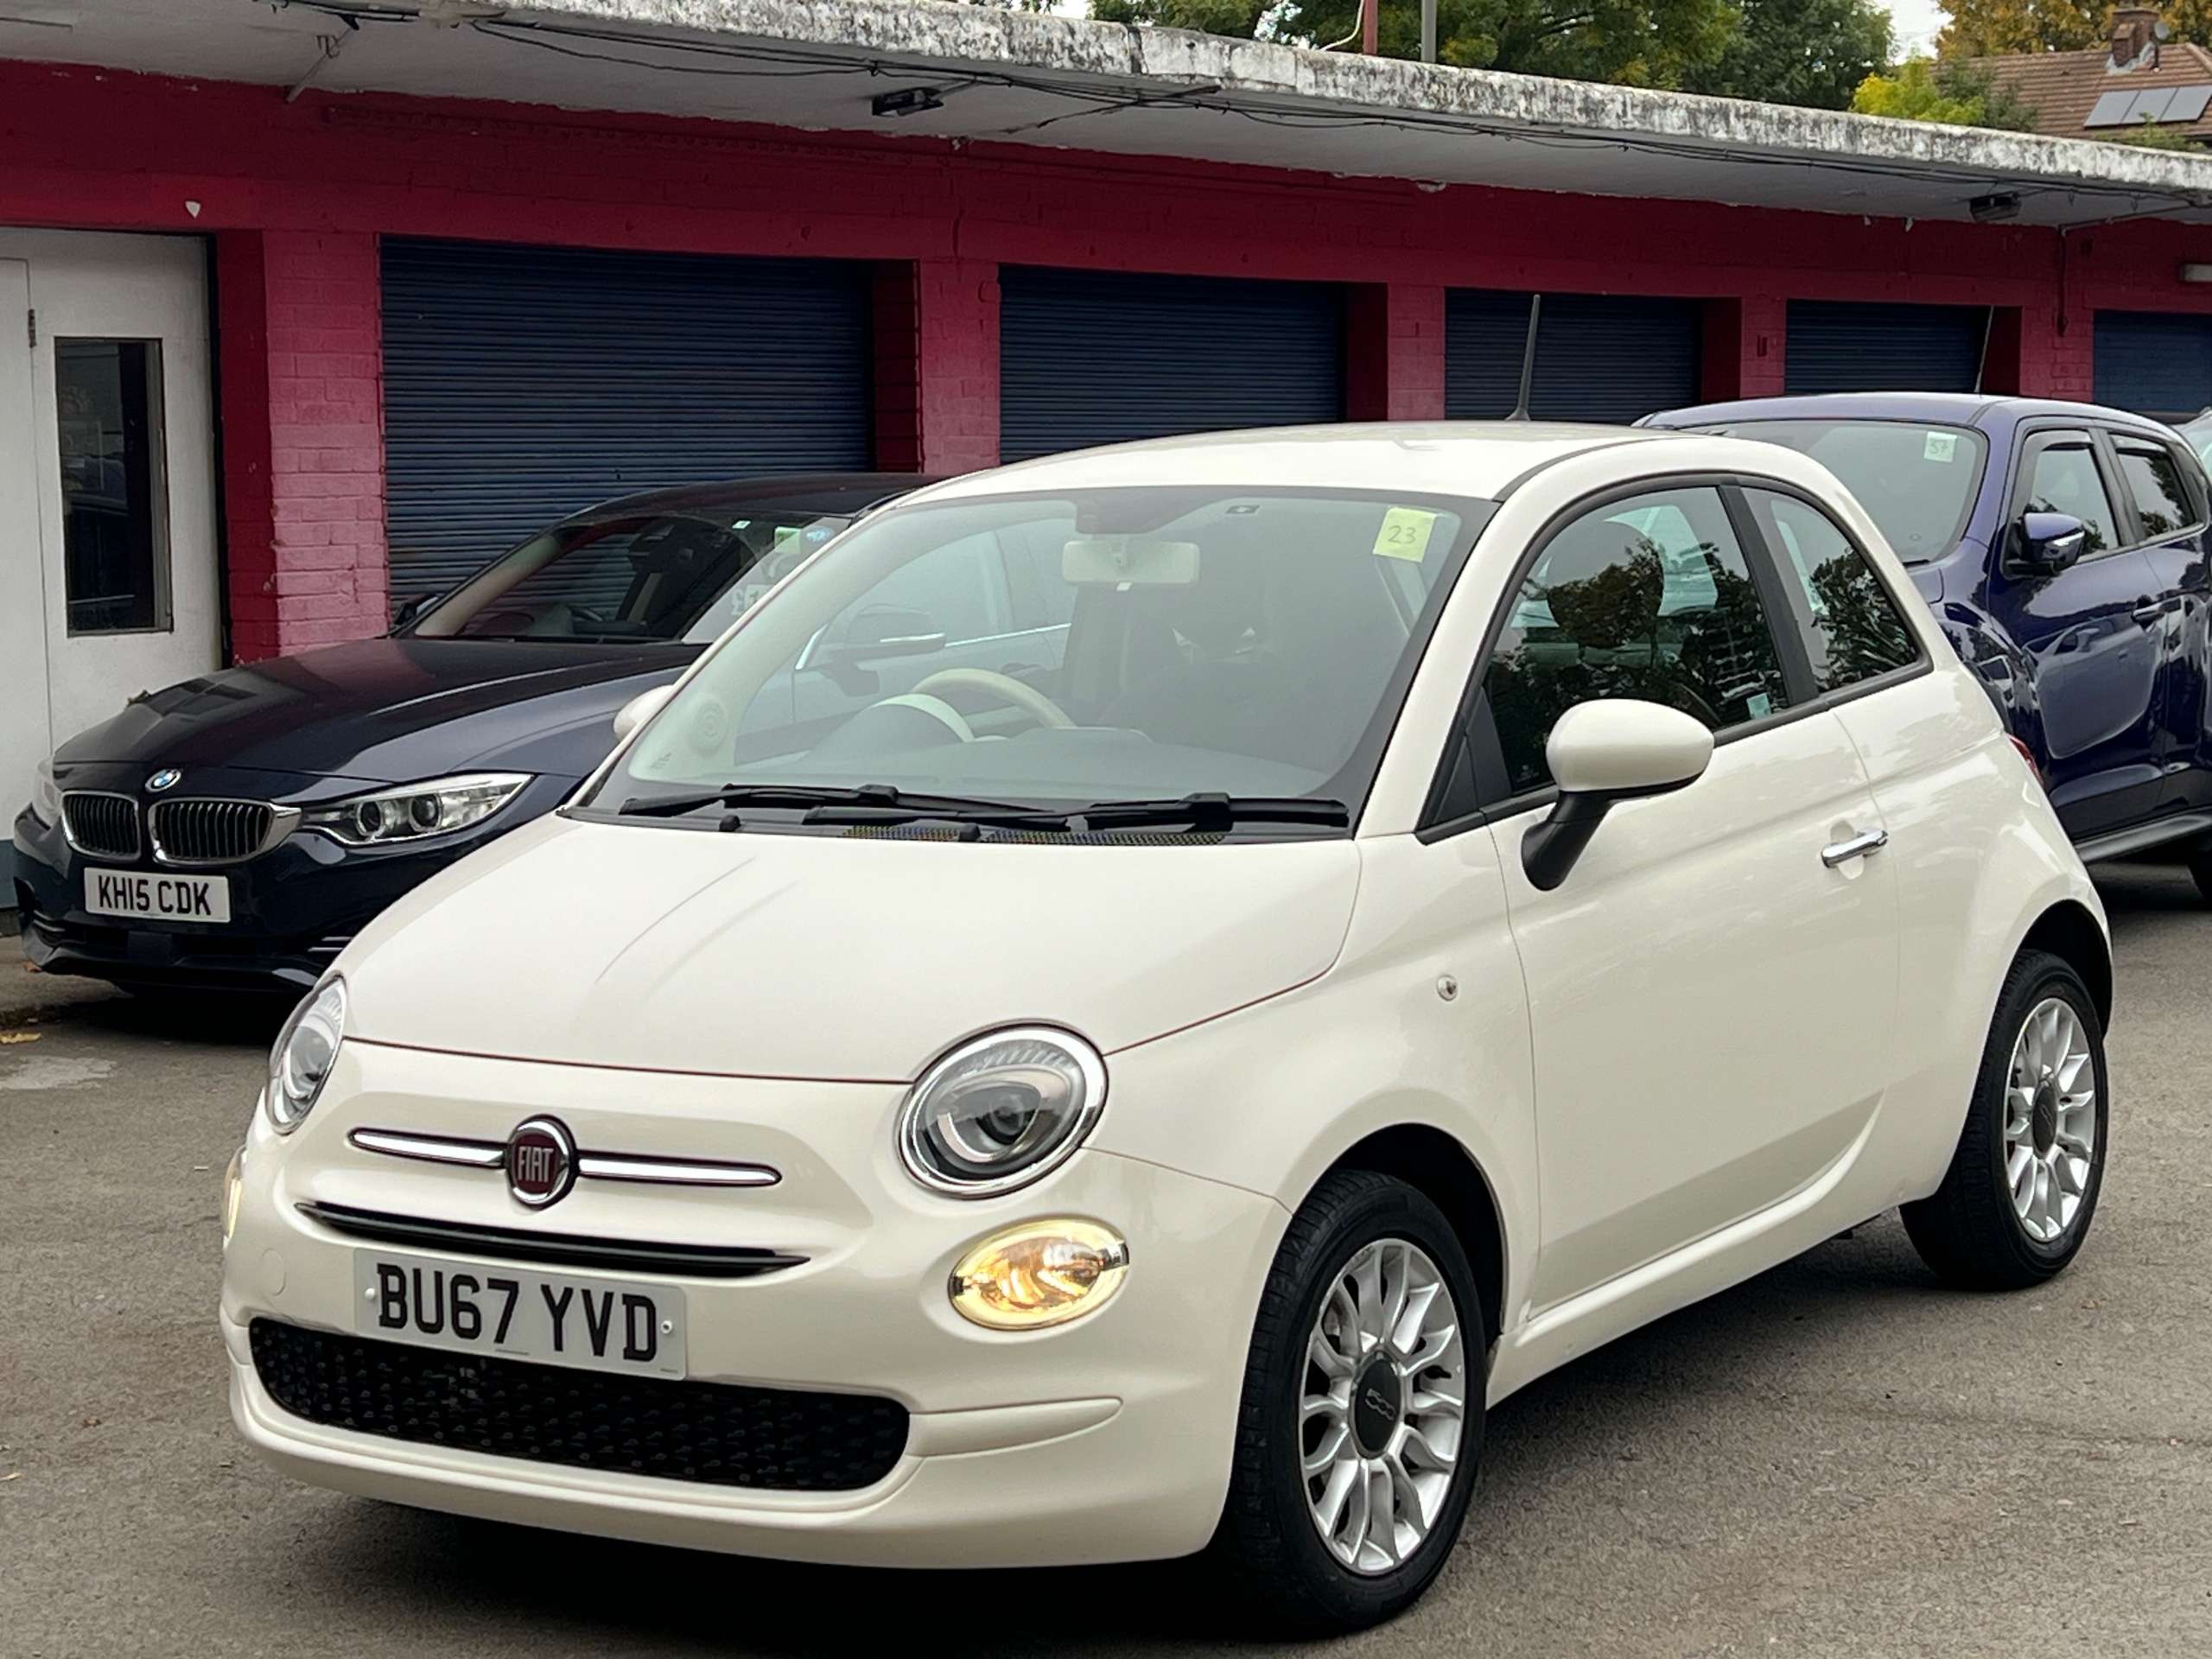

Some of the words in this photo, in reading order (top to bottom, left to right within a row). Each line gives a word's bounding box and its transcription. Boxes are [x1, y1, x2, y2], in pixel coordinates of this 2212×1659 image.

[1387, 524, 1417, 544] 23
[98, 875, 150, 912] KH15
[158, 880, 211, 916] CDK
[517, 1146, 554, 1183] FIAT
[376, 1262, 519, 1344] BU67
[541, 1282, 658, 1363] YVD
